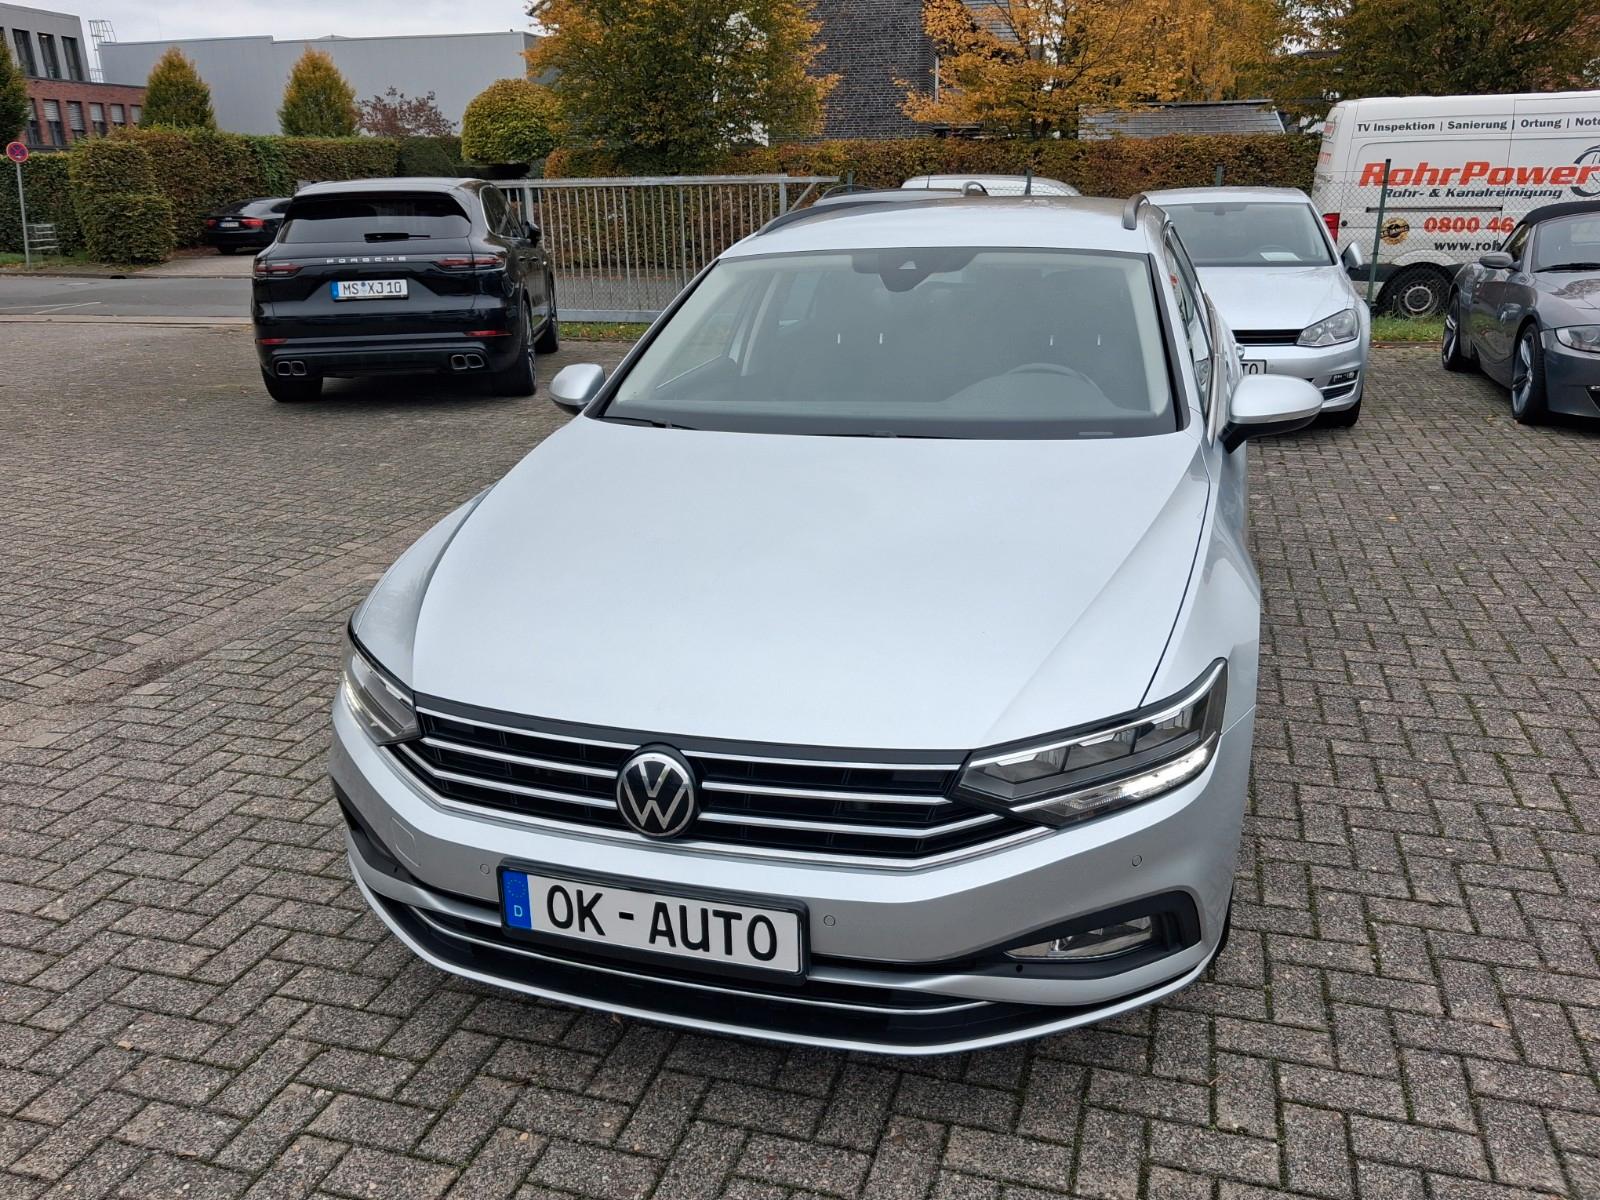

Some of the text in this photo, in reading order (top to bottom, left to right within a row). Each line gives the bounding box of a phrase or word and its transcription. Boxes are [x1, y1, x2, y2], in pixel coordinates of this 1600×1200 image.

[1357, 123, 1370, 132] TV
[1374, 121, 1435, 132] Inspektion
[1447, 120, 1508, 130] Sanierung
[1520, 118, 1562, 129] Ortung
[1358, 161, 1600, 187] RohrPower
[1385, 187, 1563, 199] Rohr- & Kanalreinigung
[1423, 216, 1481, 233] 0800
[1486, 216, 1515, 233] 46
[326, 256, 407, 264] PORSCHE
[343, 282, 359, 295] MS
[513, 904, 523, 917] D
[546, 884, 605, 936] OK
[648, 901, 777, 962] AUTO
